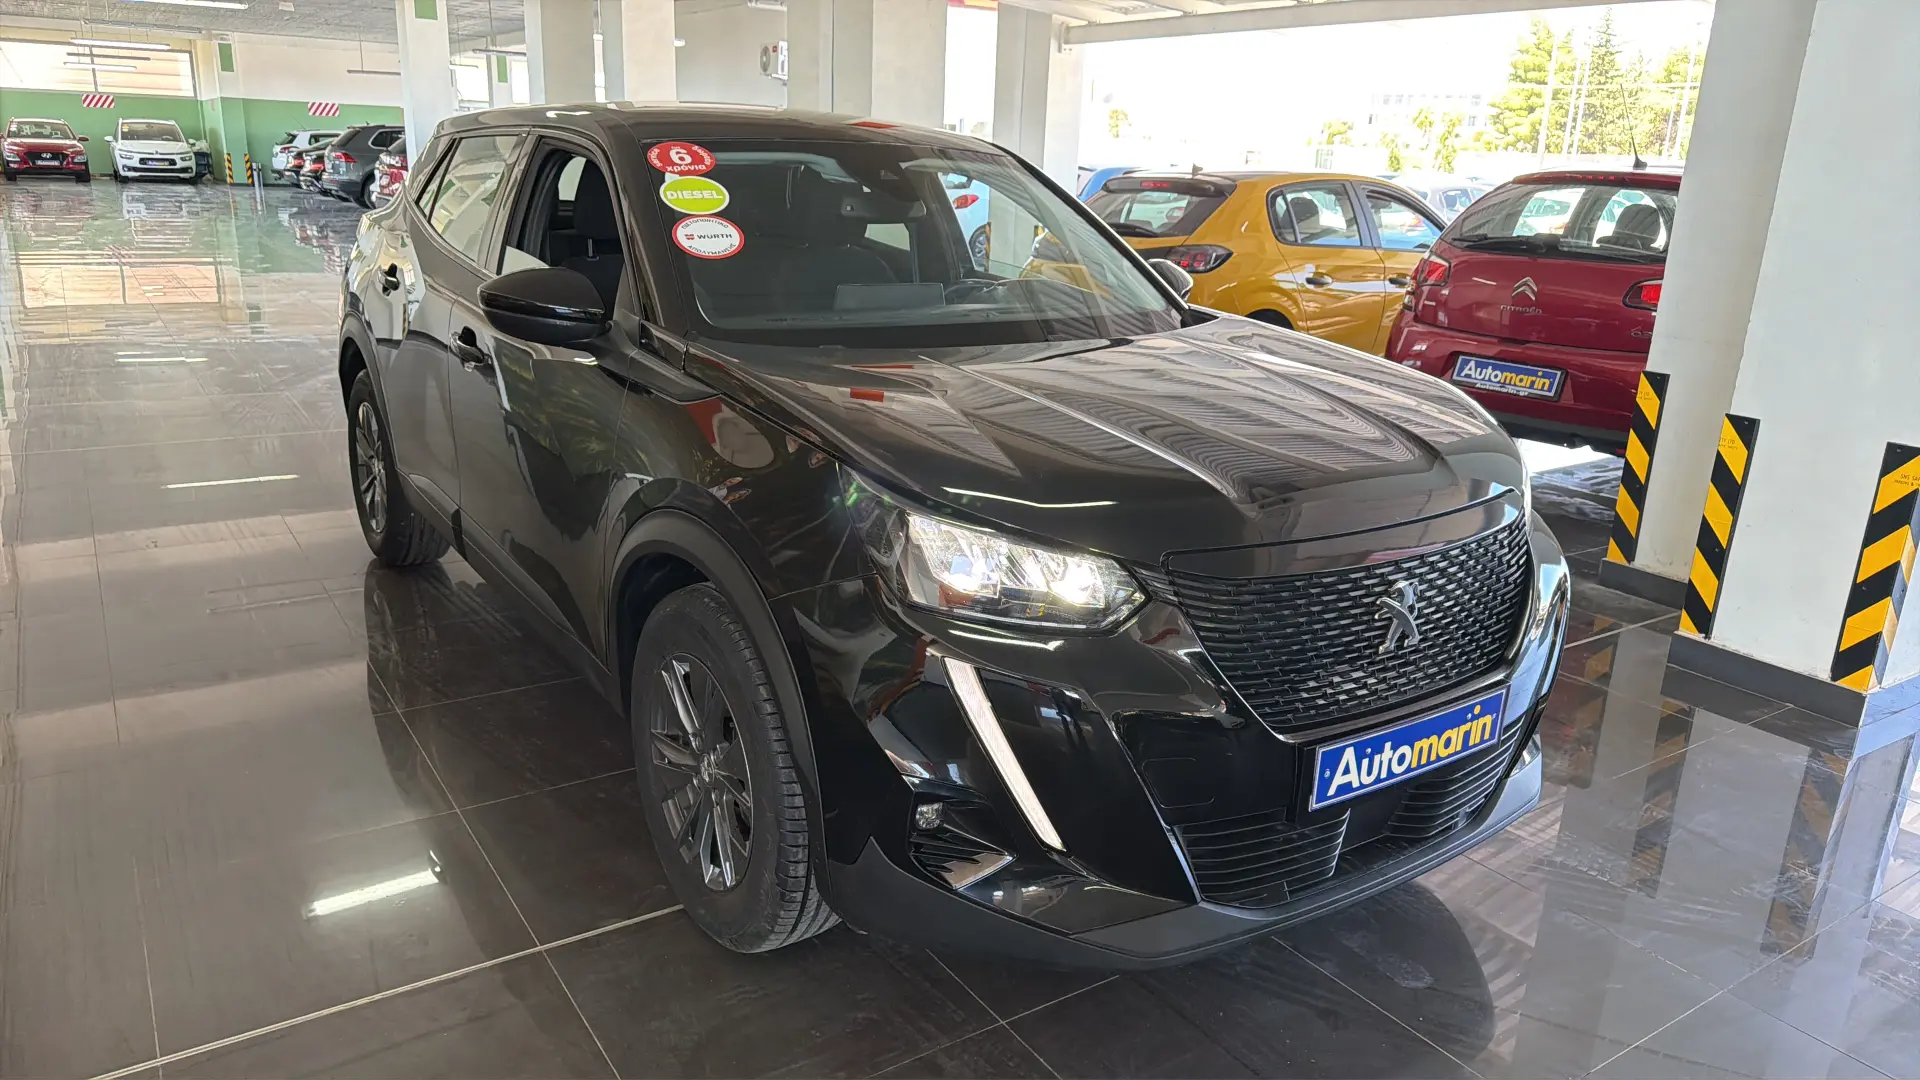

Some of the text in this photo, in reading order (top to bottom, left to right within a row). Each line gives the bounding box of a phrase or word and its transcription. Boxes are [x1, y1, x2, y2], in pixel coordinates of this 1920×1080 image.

[669, 148, 692, 165] 6
[666, 164, 706, 172] χρόνια
[667, 190, 723, 200] DIESEL
[1460, 358, 1551, 391] Automarin
[1475, 382, 1529, 397] Automarin.gr
[1326, 704, 1493, 797] Automarin
